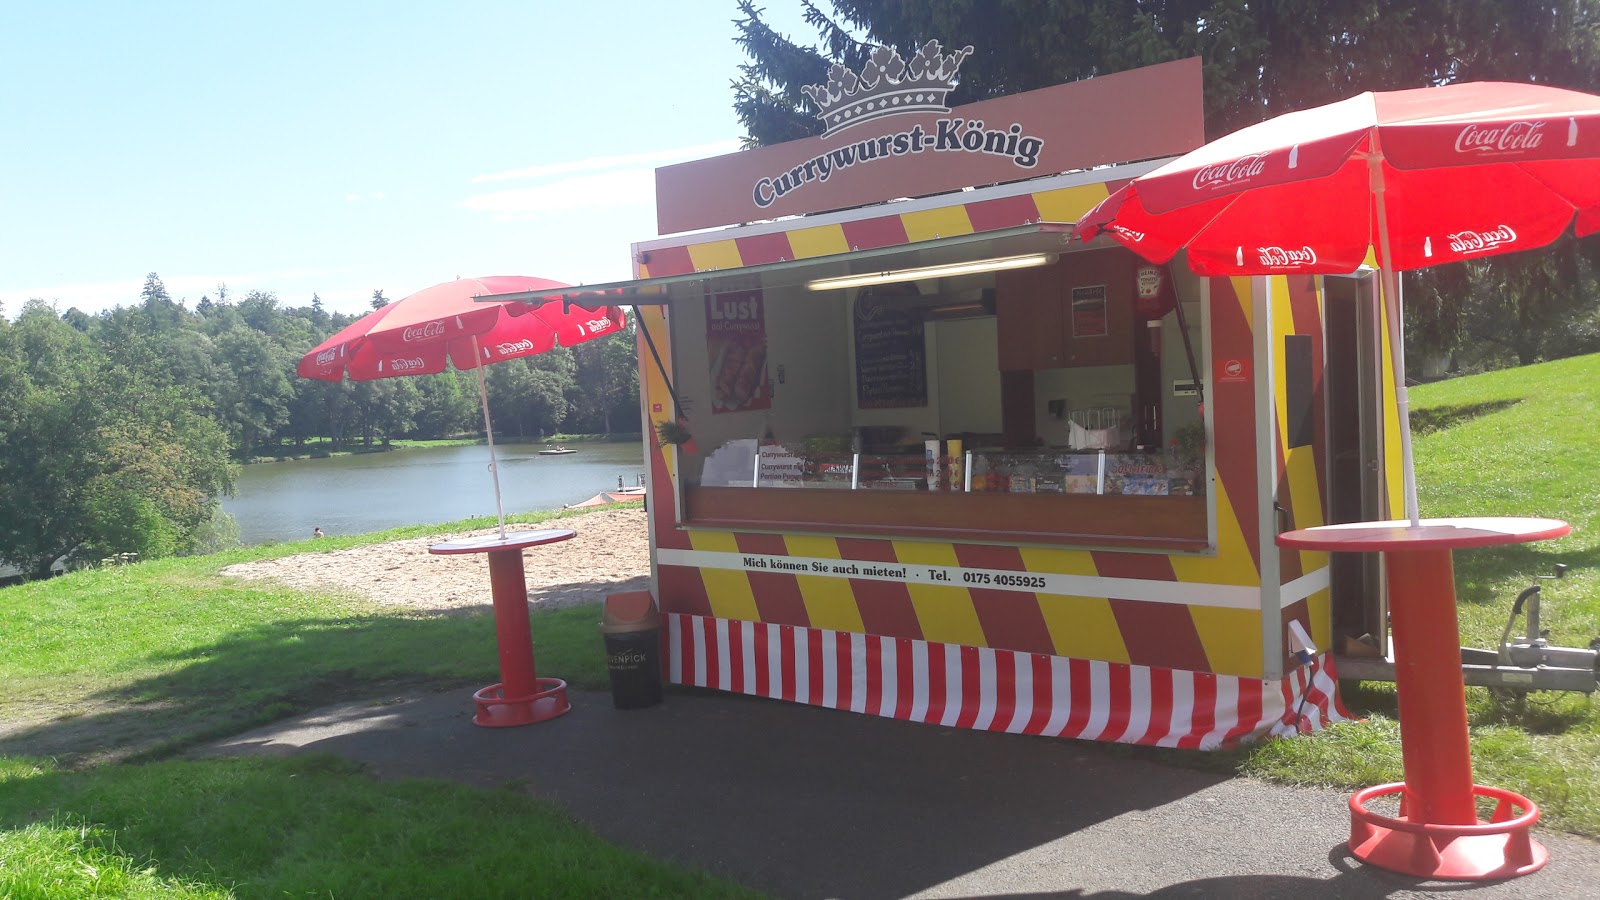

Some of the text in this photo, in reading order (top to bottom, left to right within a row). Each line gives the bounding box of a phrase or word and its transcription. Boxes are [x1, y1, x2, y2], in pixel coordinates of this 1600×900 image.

[1454, 121, 1546, 153] Coca-Cola
[753, 119, 1044, 208] Currywurst-König
[1192, 150, 1272, 190] Coca-Cola
[711, 291, 759, 320] Lust
[402, 319, 446, 343] Coca-Cola
[761, 463, 792, 471] Currywurst
[743, 556, 1046, 589] Mich können Sie auch mieten! Tel. 0175 4055925
